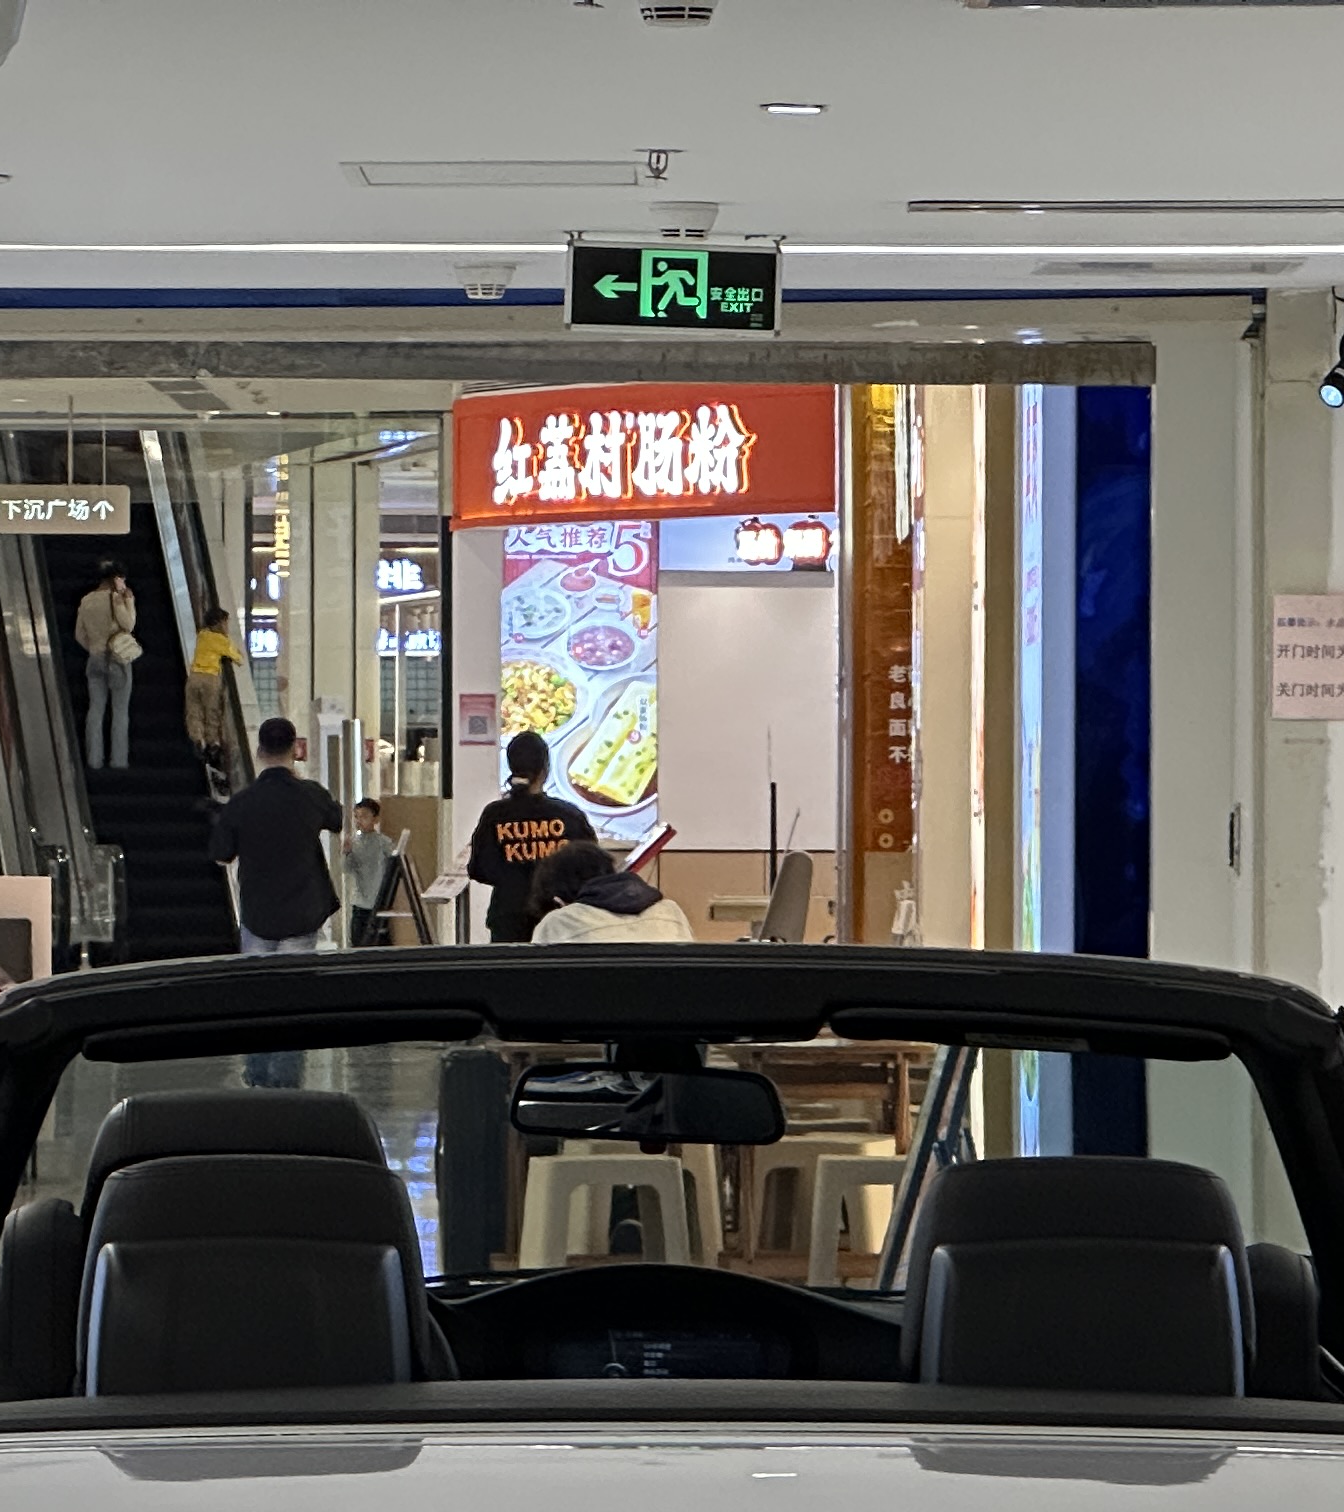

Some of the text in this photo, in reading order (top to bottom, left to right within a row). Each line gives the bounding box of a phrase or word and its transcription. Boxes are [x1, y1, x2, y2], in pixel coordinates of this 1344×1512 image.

[710, 287, 763, 302] 安全出口
[720, 302, 753, 313] EXIT
[491, 403, 748, 505] 红荔村肠粉
[2, 499, 89, 522] 下沉广场
[508, 526, 608, 549] 人气推荐
[611, 522, 646, 574] 5
[497, 819, 565, 841] KUMO
